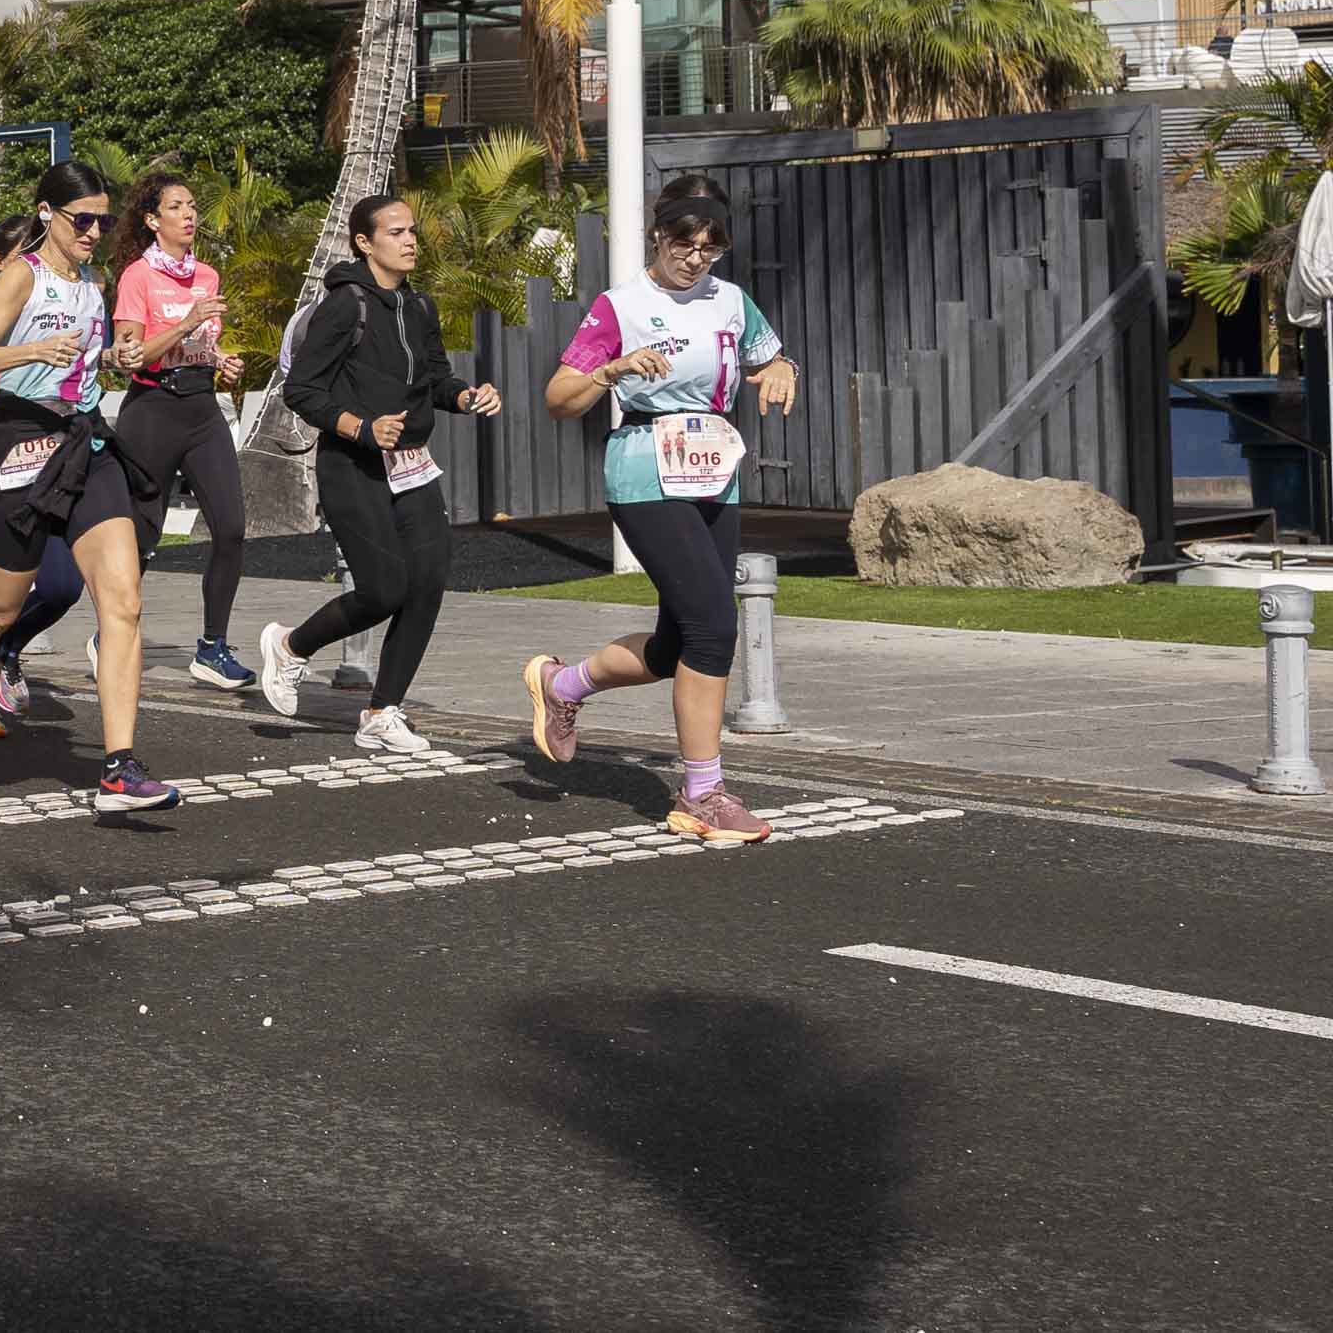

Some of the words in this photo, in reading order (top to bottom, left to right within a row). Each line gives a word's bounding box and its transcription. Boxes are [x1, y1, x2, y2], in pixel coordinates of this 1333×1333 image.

[646, 336, 690, 349] unning
[186, 351, 206, 363] 016
[24, 436, 57, 454] 016
[689, 452, 721, 466] 016
